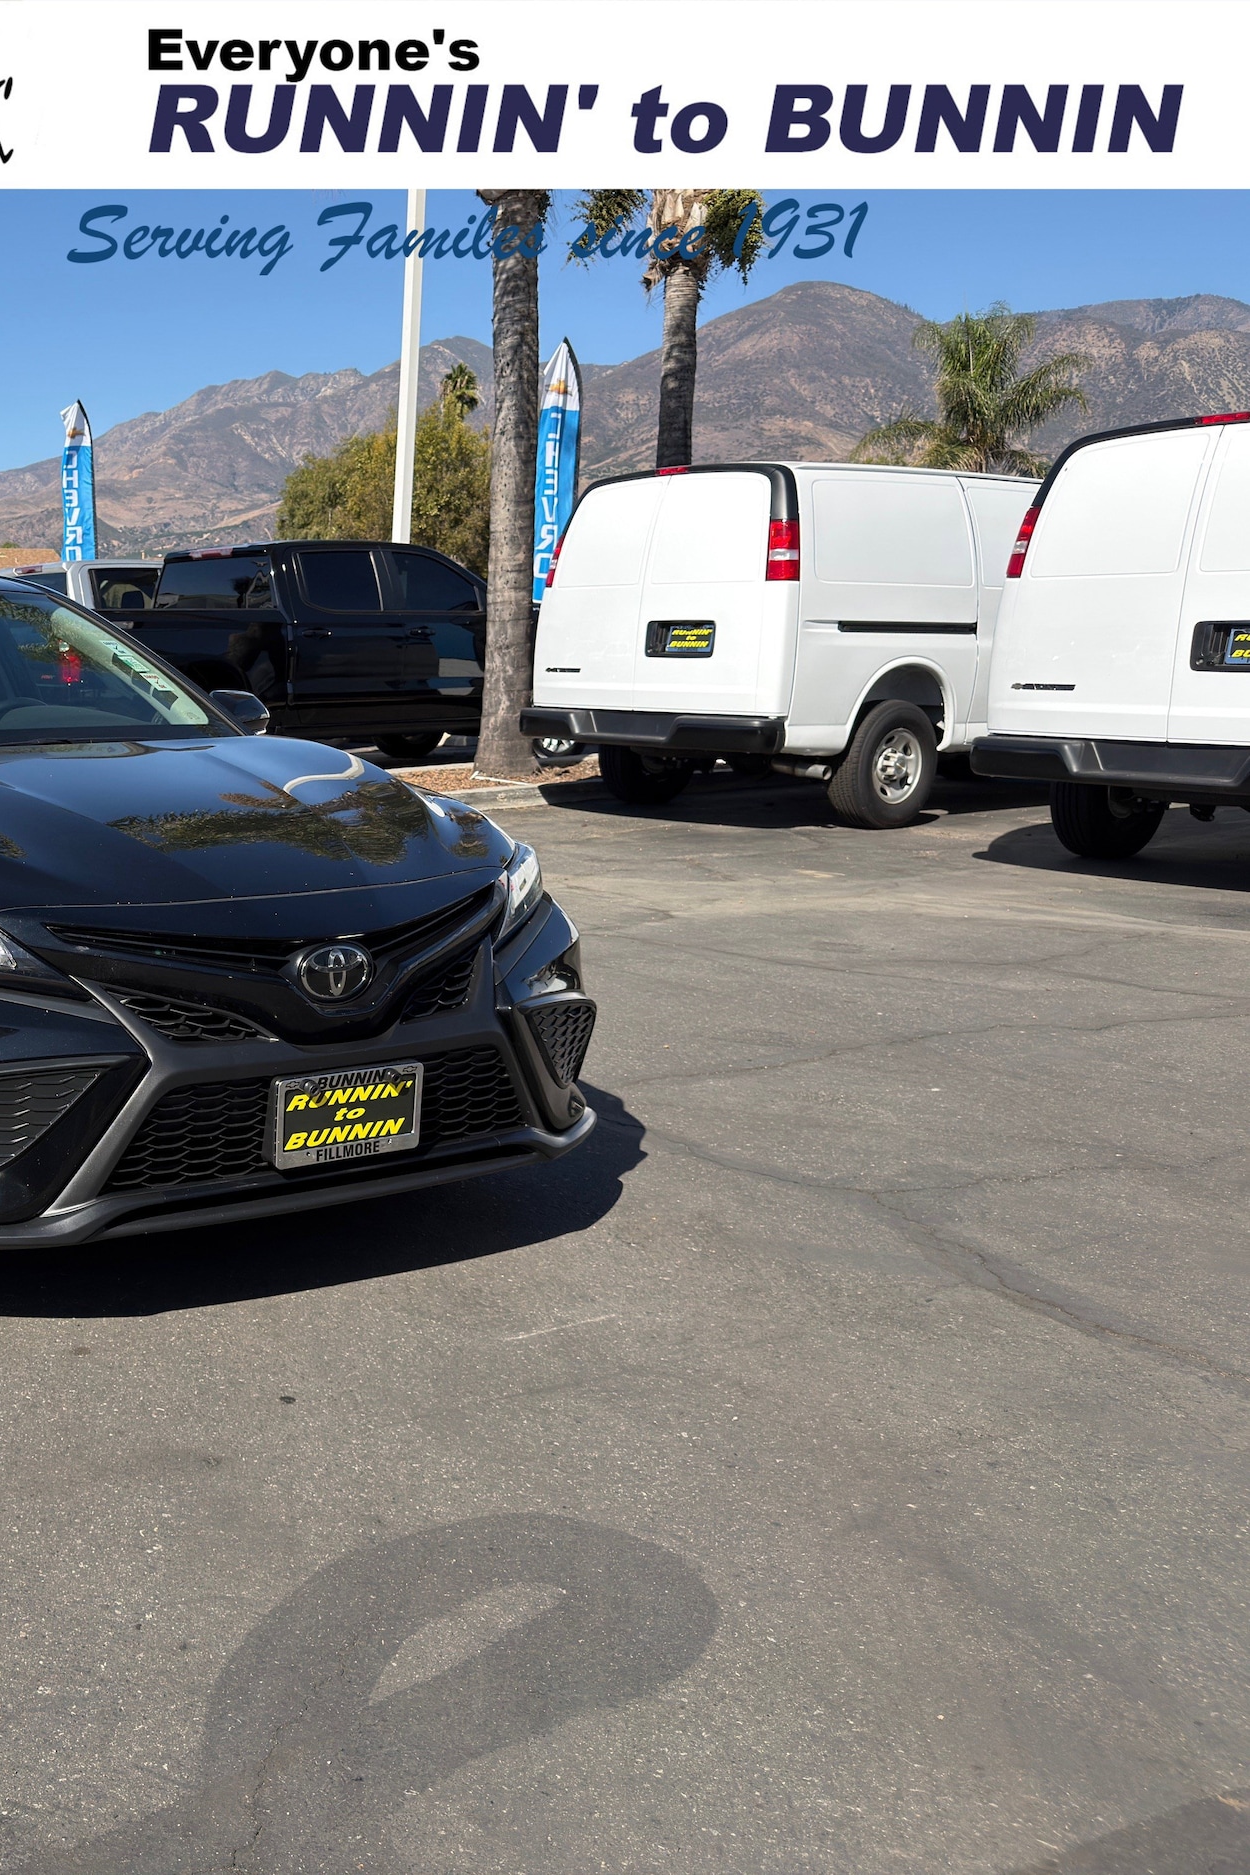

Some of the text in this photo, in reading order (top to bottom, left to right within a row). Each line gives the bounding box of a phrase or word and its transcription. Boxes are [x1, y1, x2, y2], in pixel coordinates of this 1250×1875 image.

[317, 1069, 387, 1090] BUNNIN
[286, 1080, 414, 1112] RUNNIN'
[333, 1107, 366, 1122] to
[284, 1117, 406, 1151] BUNNIN
[316, 1140, 381, 1162] FILLMORE
